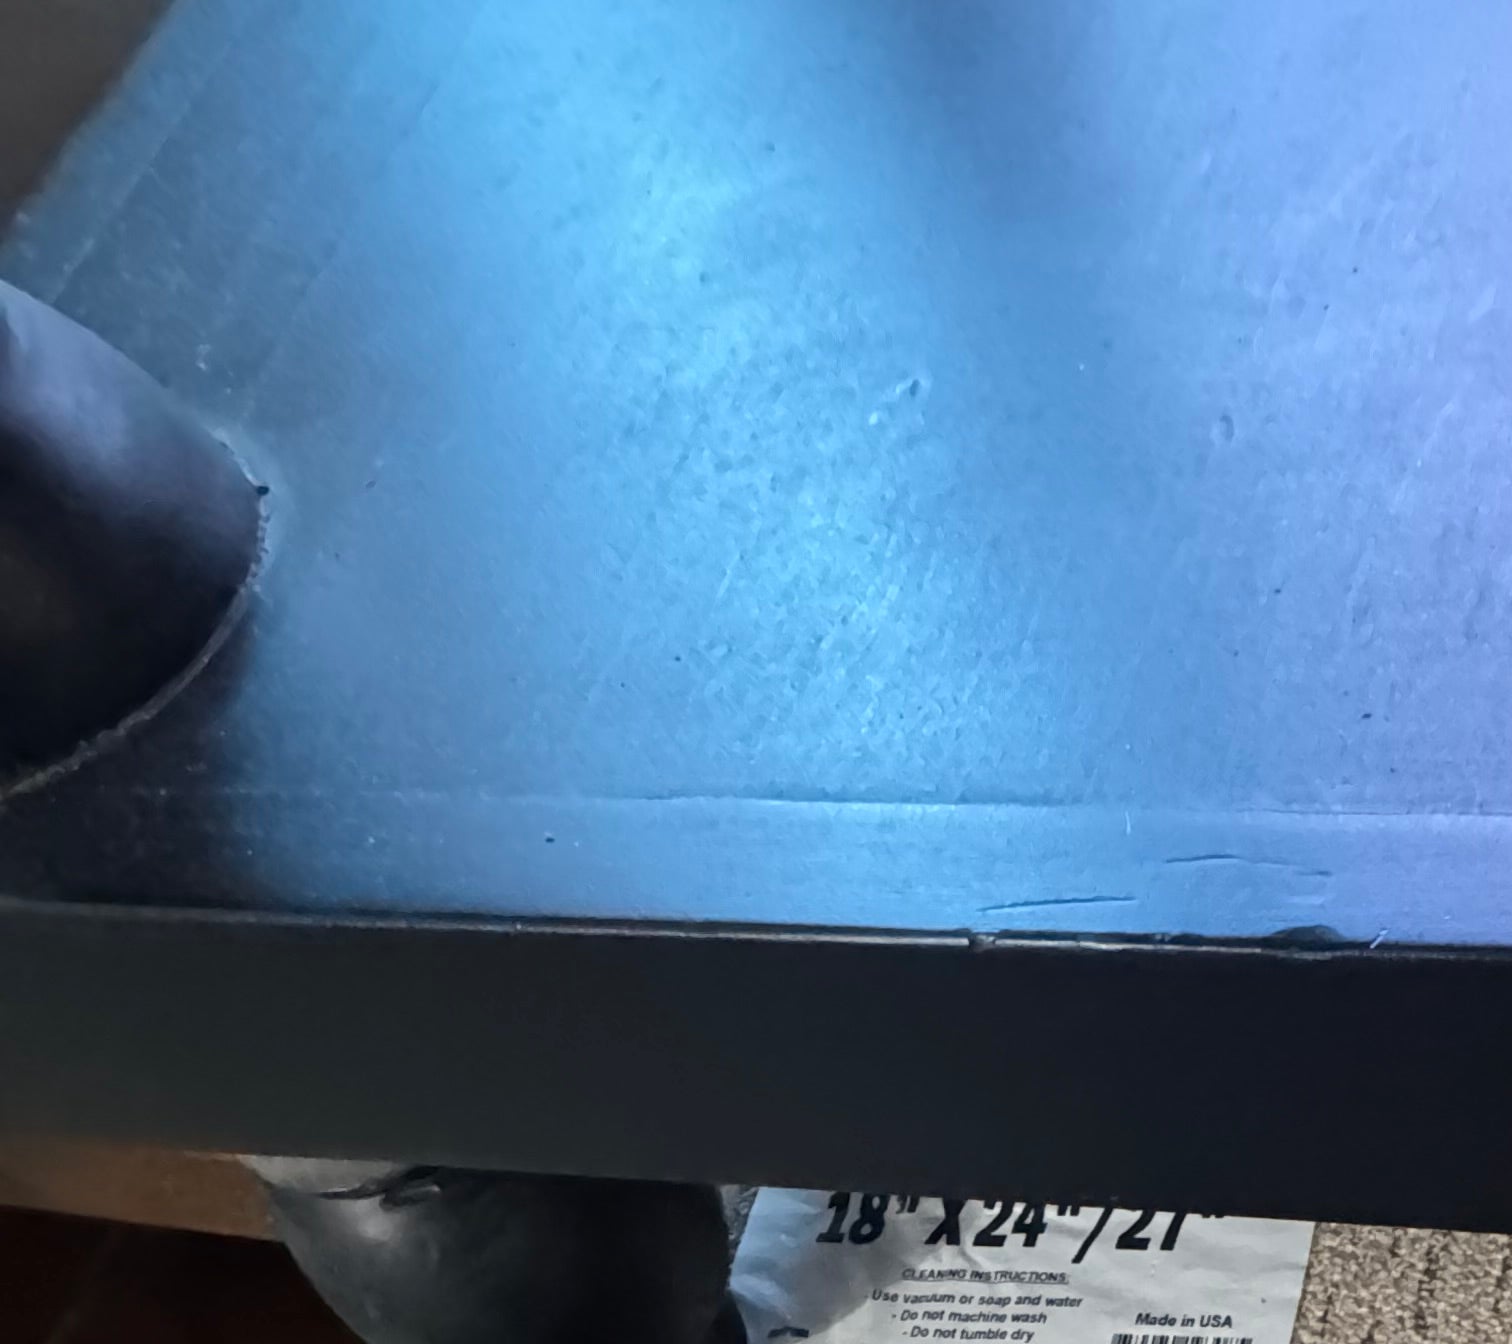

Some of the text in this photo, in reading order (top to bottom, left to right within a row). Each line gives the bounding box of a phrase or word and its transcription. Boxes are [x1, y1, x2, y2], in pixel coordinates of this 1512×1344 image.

[902, 1268, 967, 1281] CLEANING
[872, 1288, 899, 1303] Use
[903, 1293, 956, 1305] vacuum
[958, 1295, 975, 1305] or
[977, 1295, 1010, 1308] soap
[1014, 1293, 1042, 1306] and
[1045, 1296, 1083, 1308] water
[900, 1309, 918, 1322] Do
[922, 1310, 945, 1322] not
[949, 1310, 1007, 1324] machine
[1011, 1311, 1047, 1325] wash
[1135, 1312, 1233, 1329] Made in USA
[910, 1325, 929, 1338] Do
[933, 1328, 957, 1340] not
[960, 1328, 1008, 1341] tumble
[1010, 1329, 1035, 1344] dry
